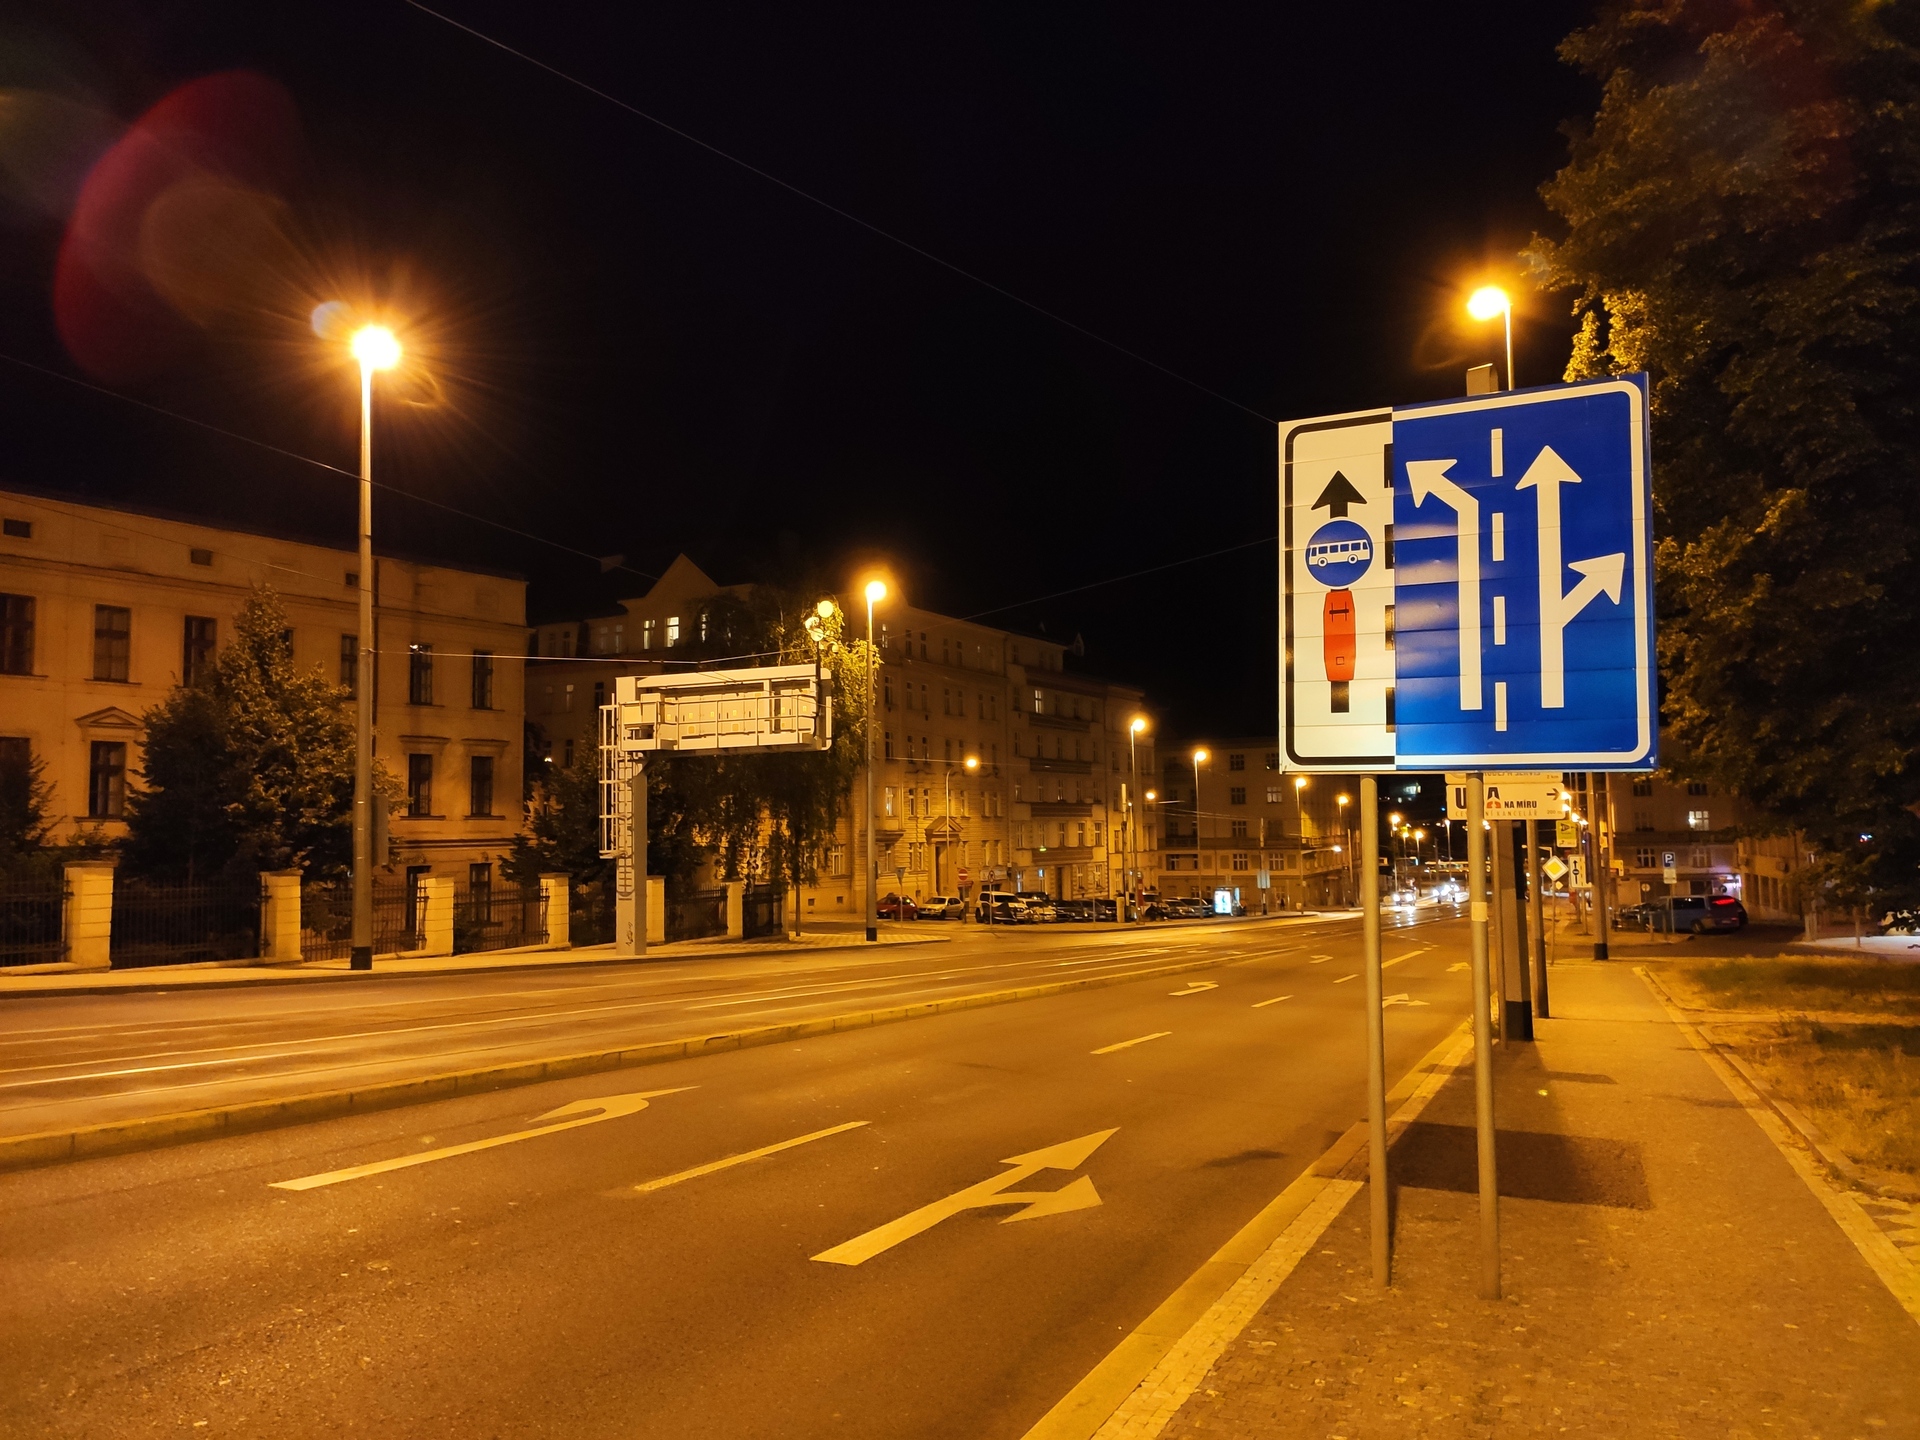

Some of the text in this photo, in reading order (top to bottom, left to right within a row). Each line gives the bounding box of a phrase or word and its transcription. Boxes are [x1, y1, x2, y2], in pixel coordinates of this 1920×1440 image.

[1504, 801, 1515, 809] NA
[1516, 800, 1537, 809] MÍRU
[1665, 854, 1673, 863] P
